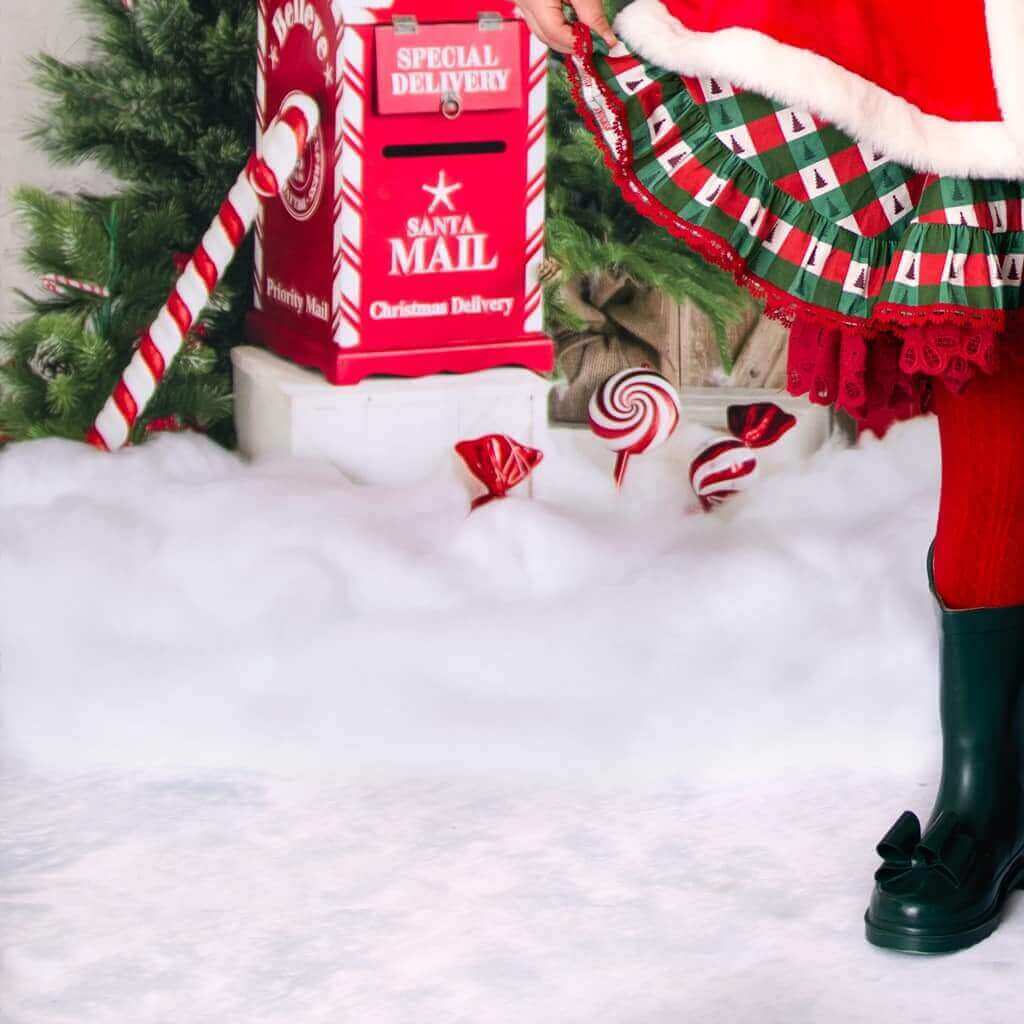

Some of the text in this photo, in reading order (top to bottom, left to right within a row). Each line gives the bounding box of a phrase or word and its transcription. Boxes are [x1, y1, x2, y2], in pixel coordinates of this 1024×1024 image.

[396, 44, 500, 70] SPECIAL
[391, 68, 511, 96] DELIVERY
[407, 214, 474, 237] SANTA
[388, 233, 499, 276] MAIL
[267, 277, 329, 322] Priority Mail
[369, 295, 515, 320] Christmas Delivery
